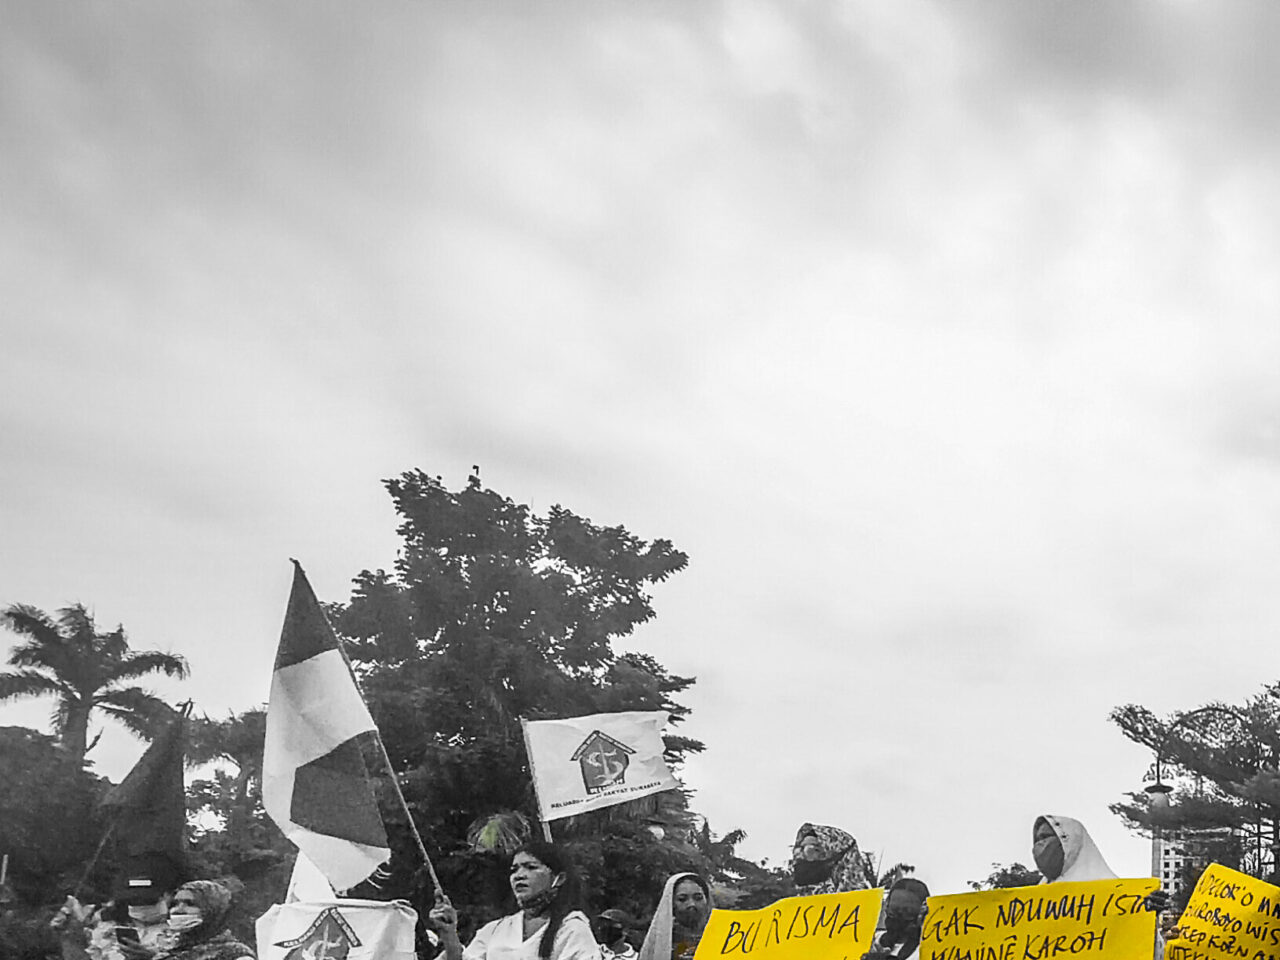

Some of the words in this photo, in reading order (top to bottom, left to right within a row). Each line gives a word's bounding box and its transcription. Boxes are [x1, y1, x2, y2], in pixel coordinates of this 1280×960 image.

[765, 903, 860, 949] RISMA
[922, 905, 985, 943] GAK
[1022, 928, 1107, 960] KAROH
